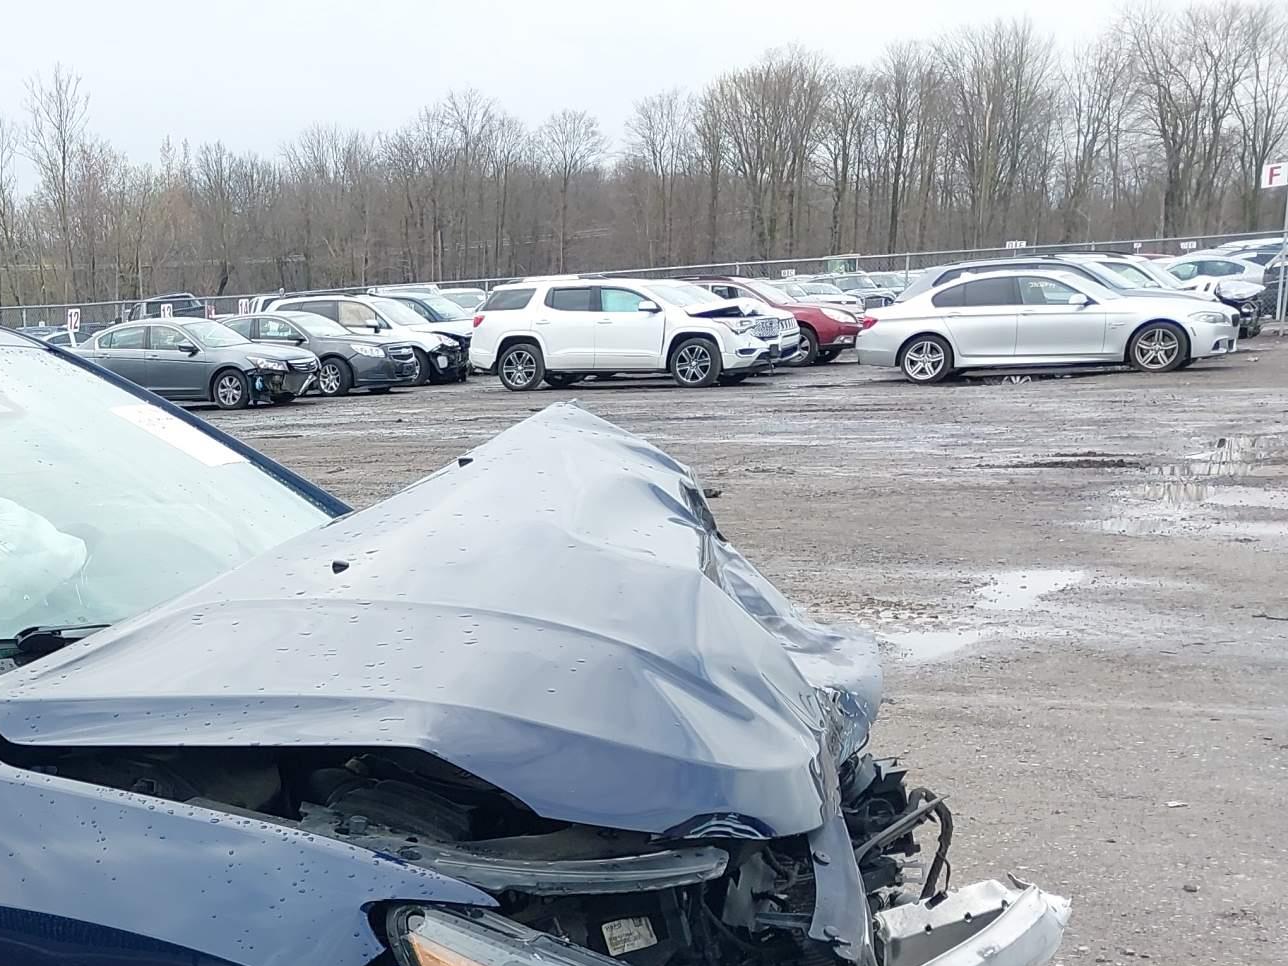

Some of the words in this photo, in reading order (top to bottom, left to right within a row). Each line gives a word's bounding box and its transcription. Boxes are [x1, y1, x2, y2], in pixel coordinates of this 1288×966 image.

[1268, 165, 1282, 186] F
[68, 311, 80, 330] 12
[161, 304, 172, 318] 13
